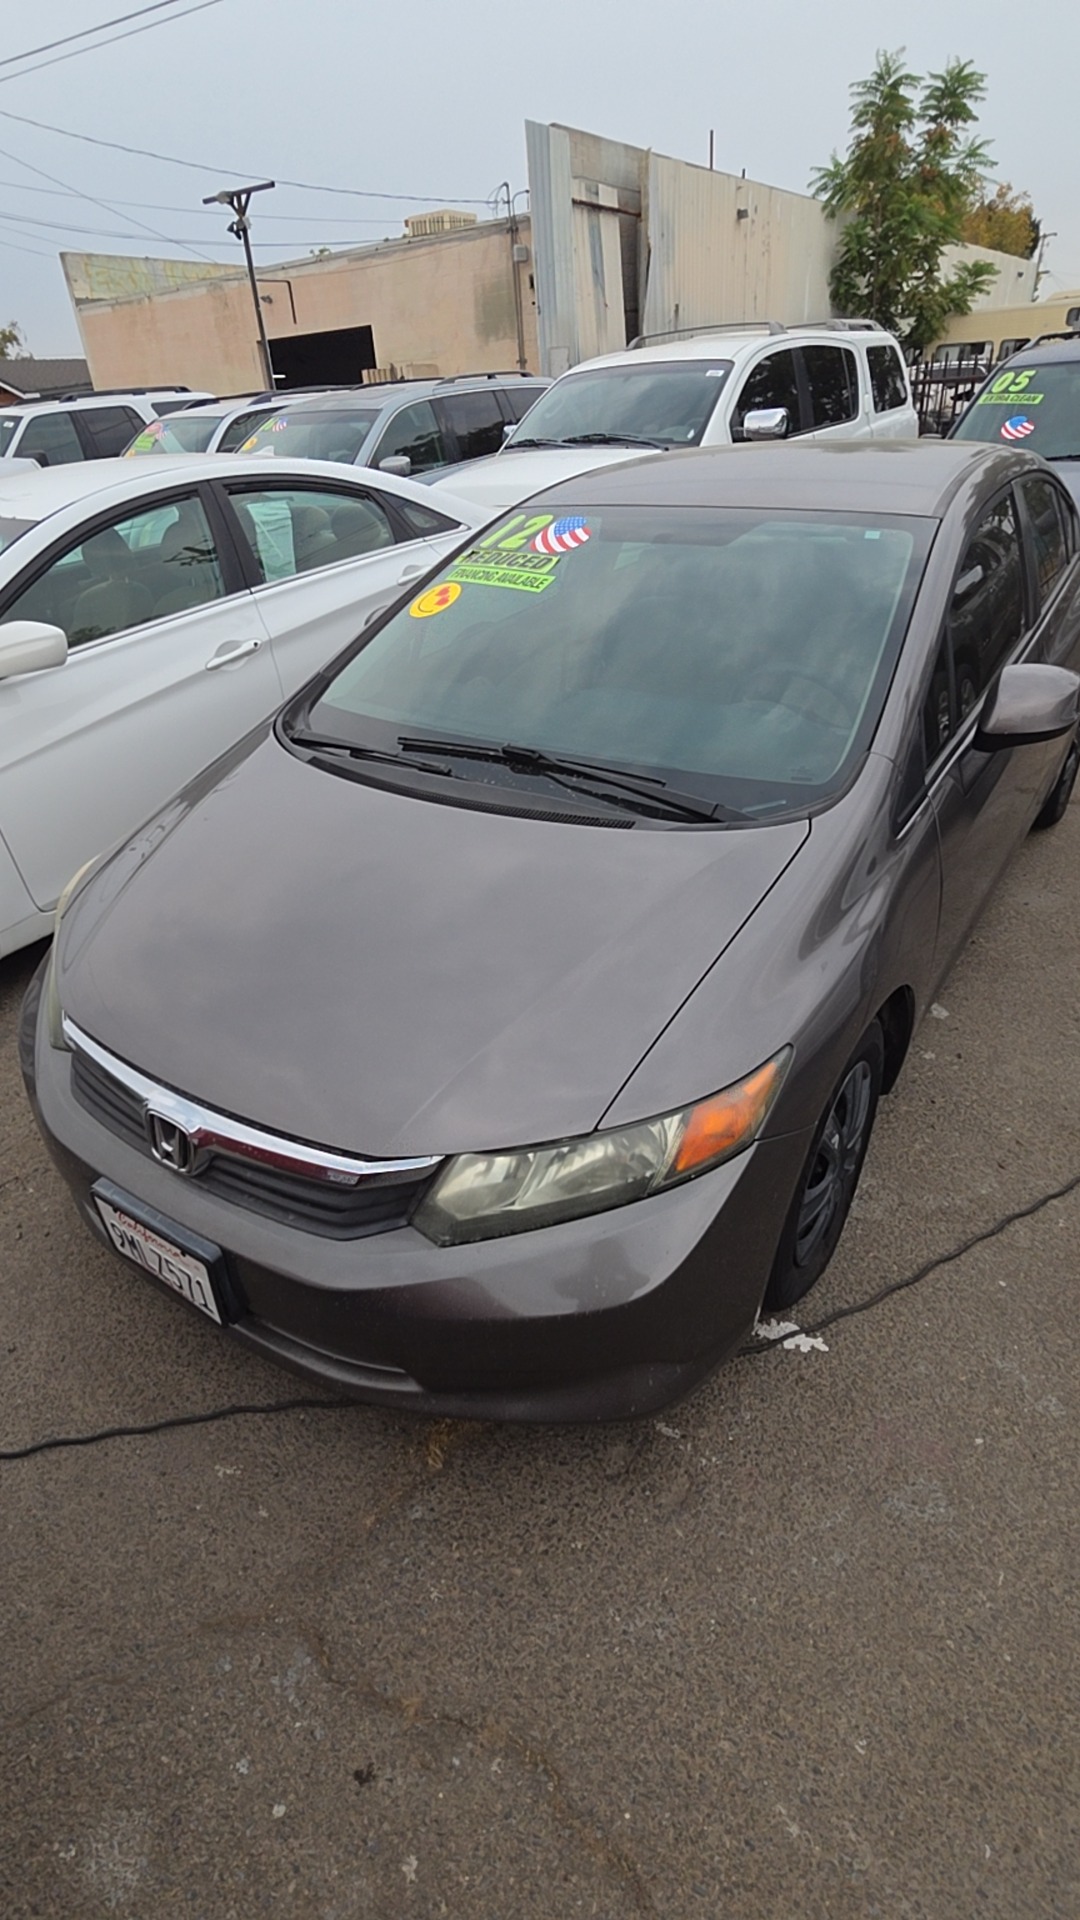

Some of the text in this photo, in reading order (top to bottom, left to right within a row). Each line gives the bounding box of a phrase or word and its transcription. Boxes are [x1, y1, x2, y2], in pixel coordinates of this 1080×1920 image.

[990, 370, 1037, 394] 05
[480, 514, 553, 549] 12
[463, 550, 554, 570] REDUCED
[452, 568, 549, 590] FINANCING AVAILABLE
[110, 1220, 215, 1315] 9MLZ571
